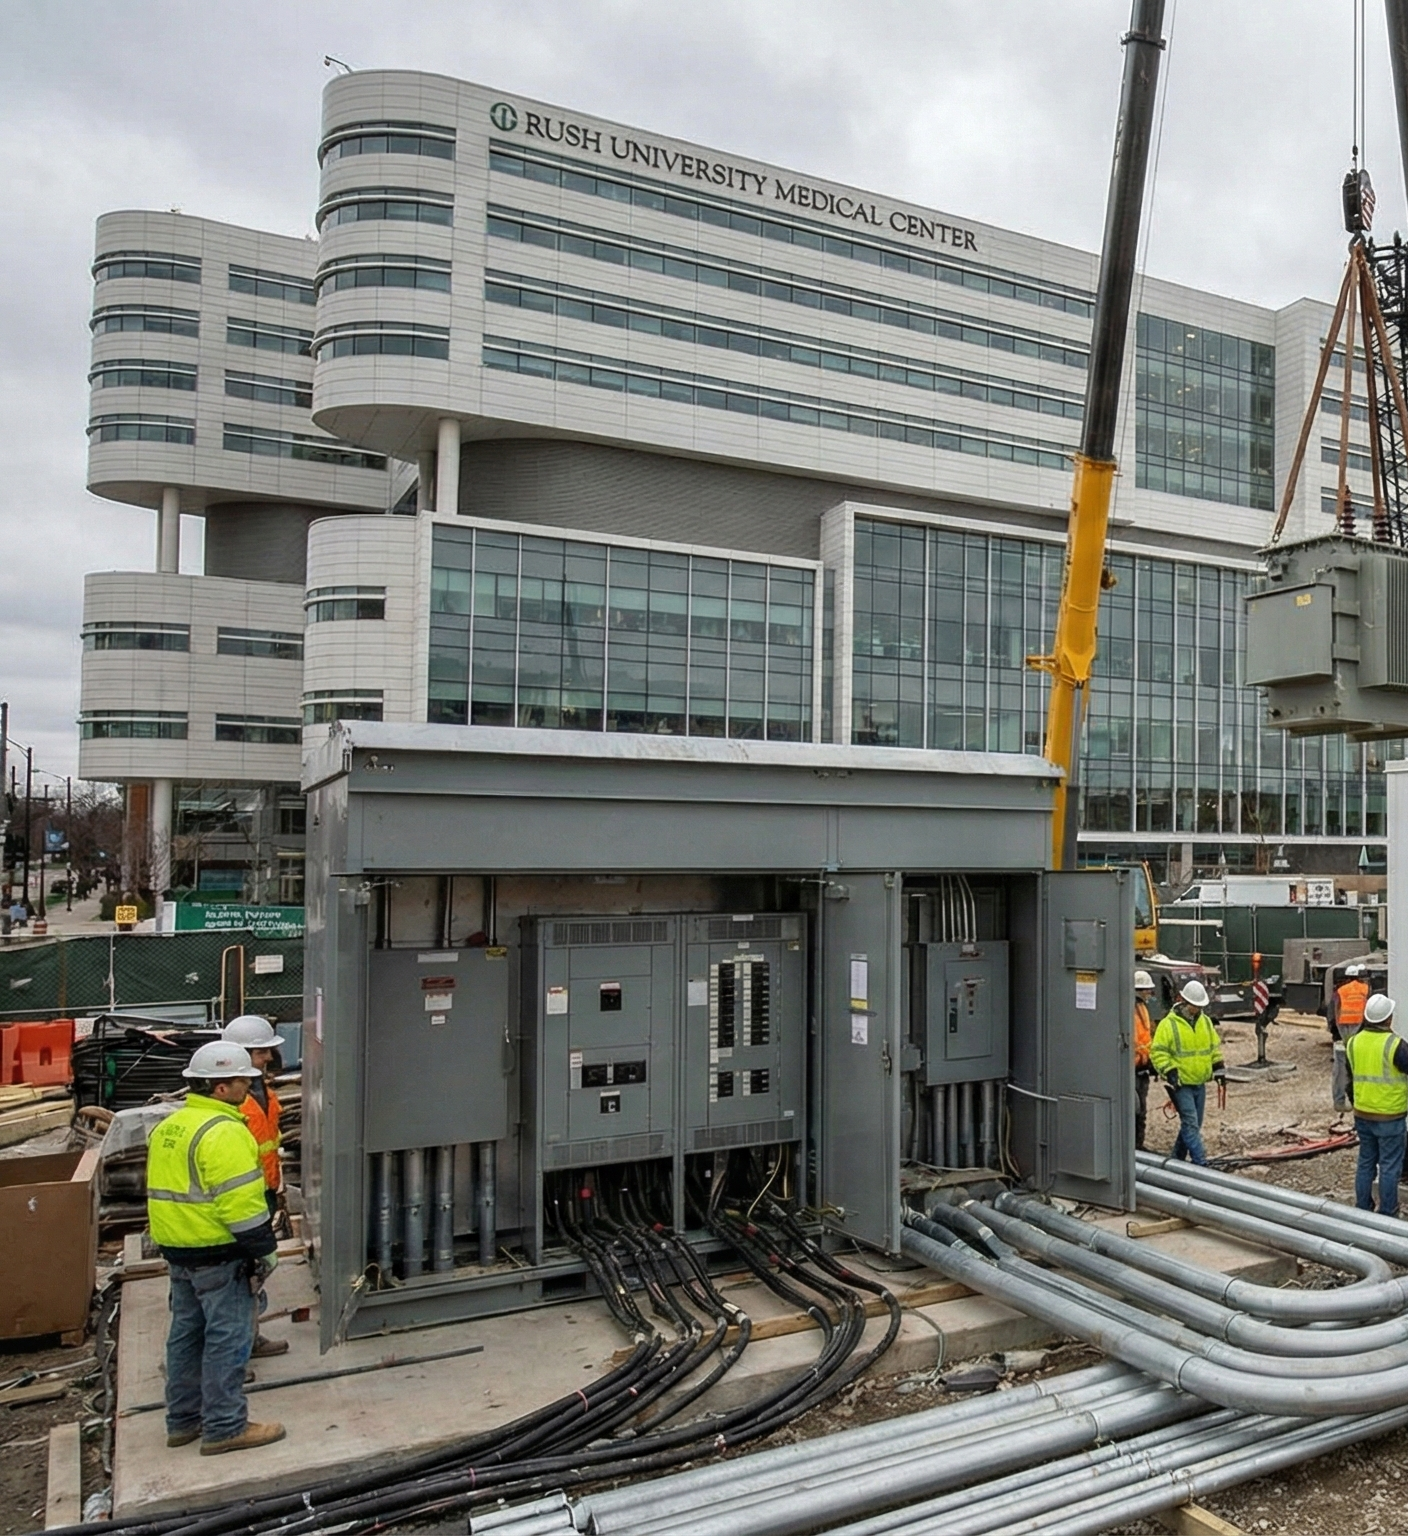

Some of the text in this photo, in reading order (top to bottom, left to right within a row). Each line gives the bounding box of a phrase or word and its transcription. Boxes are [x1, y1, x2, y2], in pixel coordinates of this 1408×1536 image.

[525, 111, 979, 252] RUSH UNIVERSITY MEDICAL CENTER
